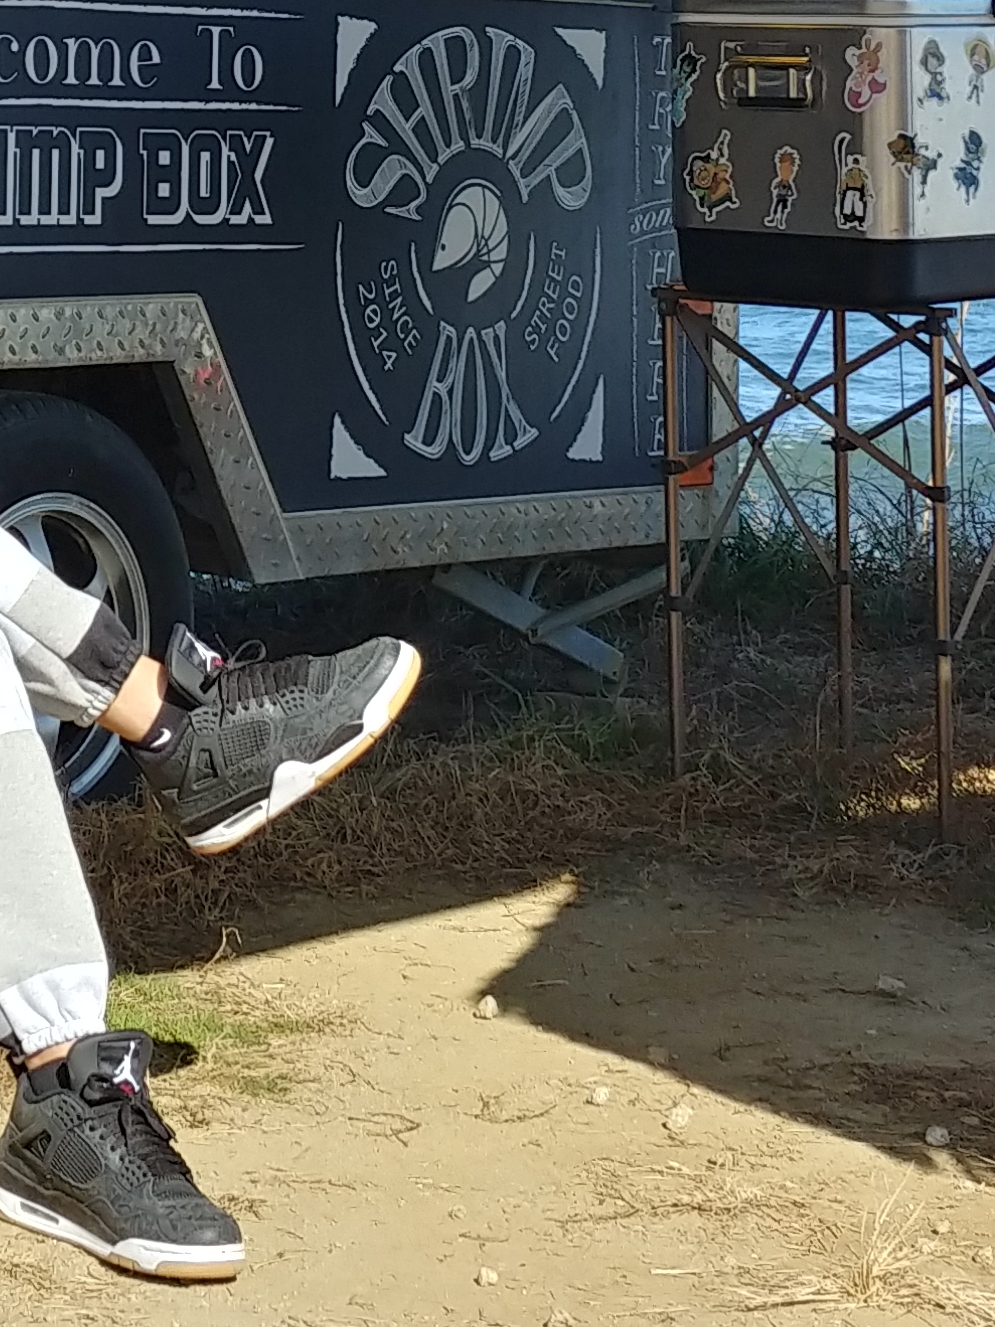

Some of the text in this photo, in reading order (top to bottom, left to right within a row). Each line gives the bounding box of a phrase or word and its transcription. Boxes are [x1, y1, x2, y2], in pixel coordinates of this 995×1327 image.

[197, 24, 265, 91] To
[345, 25, 593, 221] SHRIMP
[139, 128, 276, 226] BOX
[357, 280, 399, 372] 2014
[380, 259, 422, 356] SINCE
[523, 241, 568, 352] STREET
[545, 273, 584, 363] FOOD
[404, 320, 540, 466] BOX
